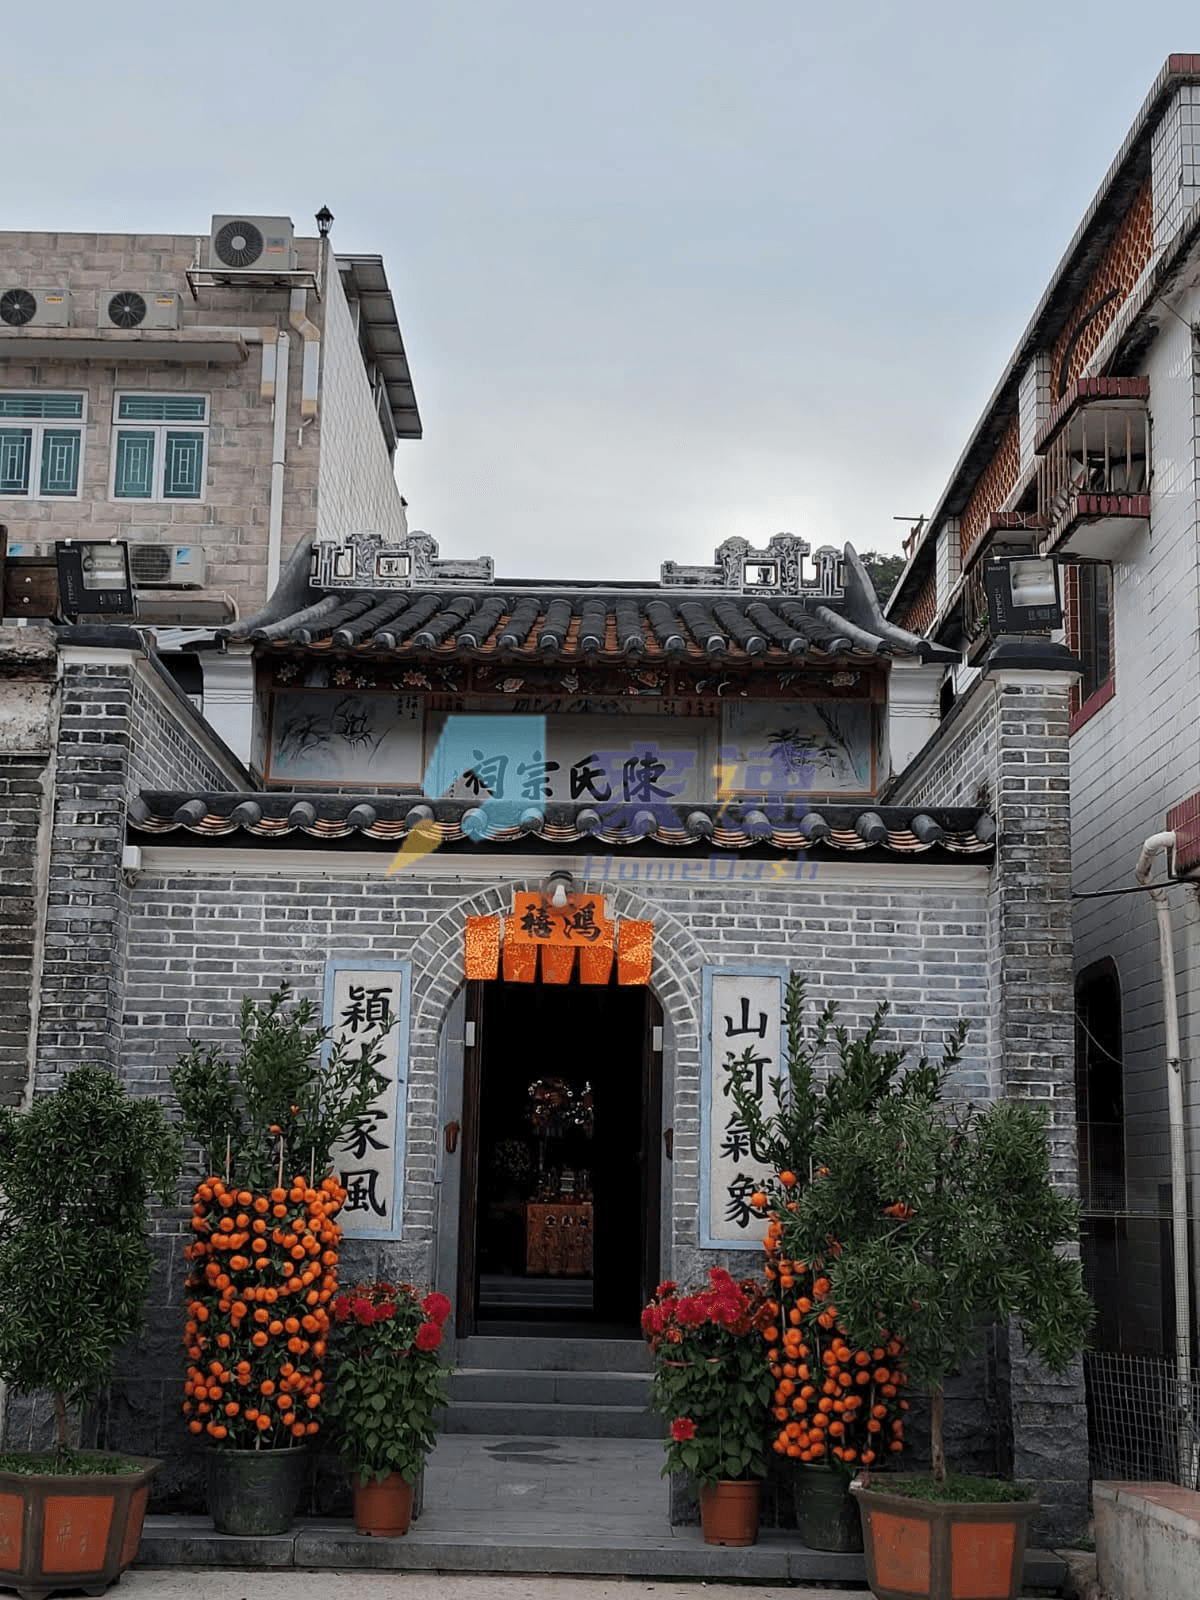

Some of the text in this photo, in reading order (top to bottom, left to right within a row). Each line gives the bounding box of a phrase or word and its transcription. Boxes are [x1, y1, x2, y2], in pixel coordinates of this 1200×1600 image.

[462, 749, 676, 802] 陳氏宗祠
[719, 997, 773, 1228] 山河氣象
